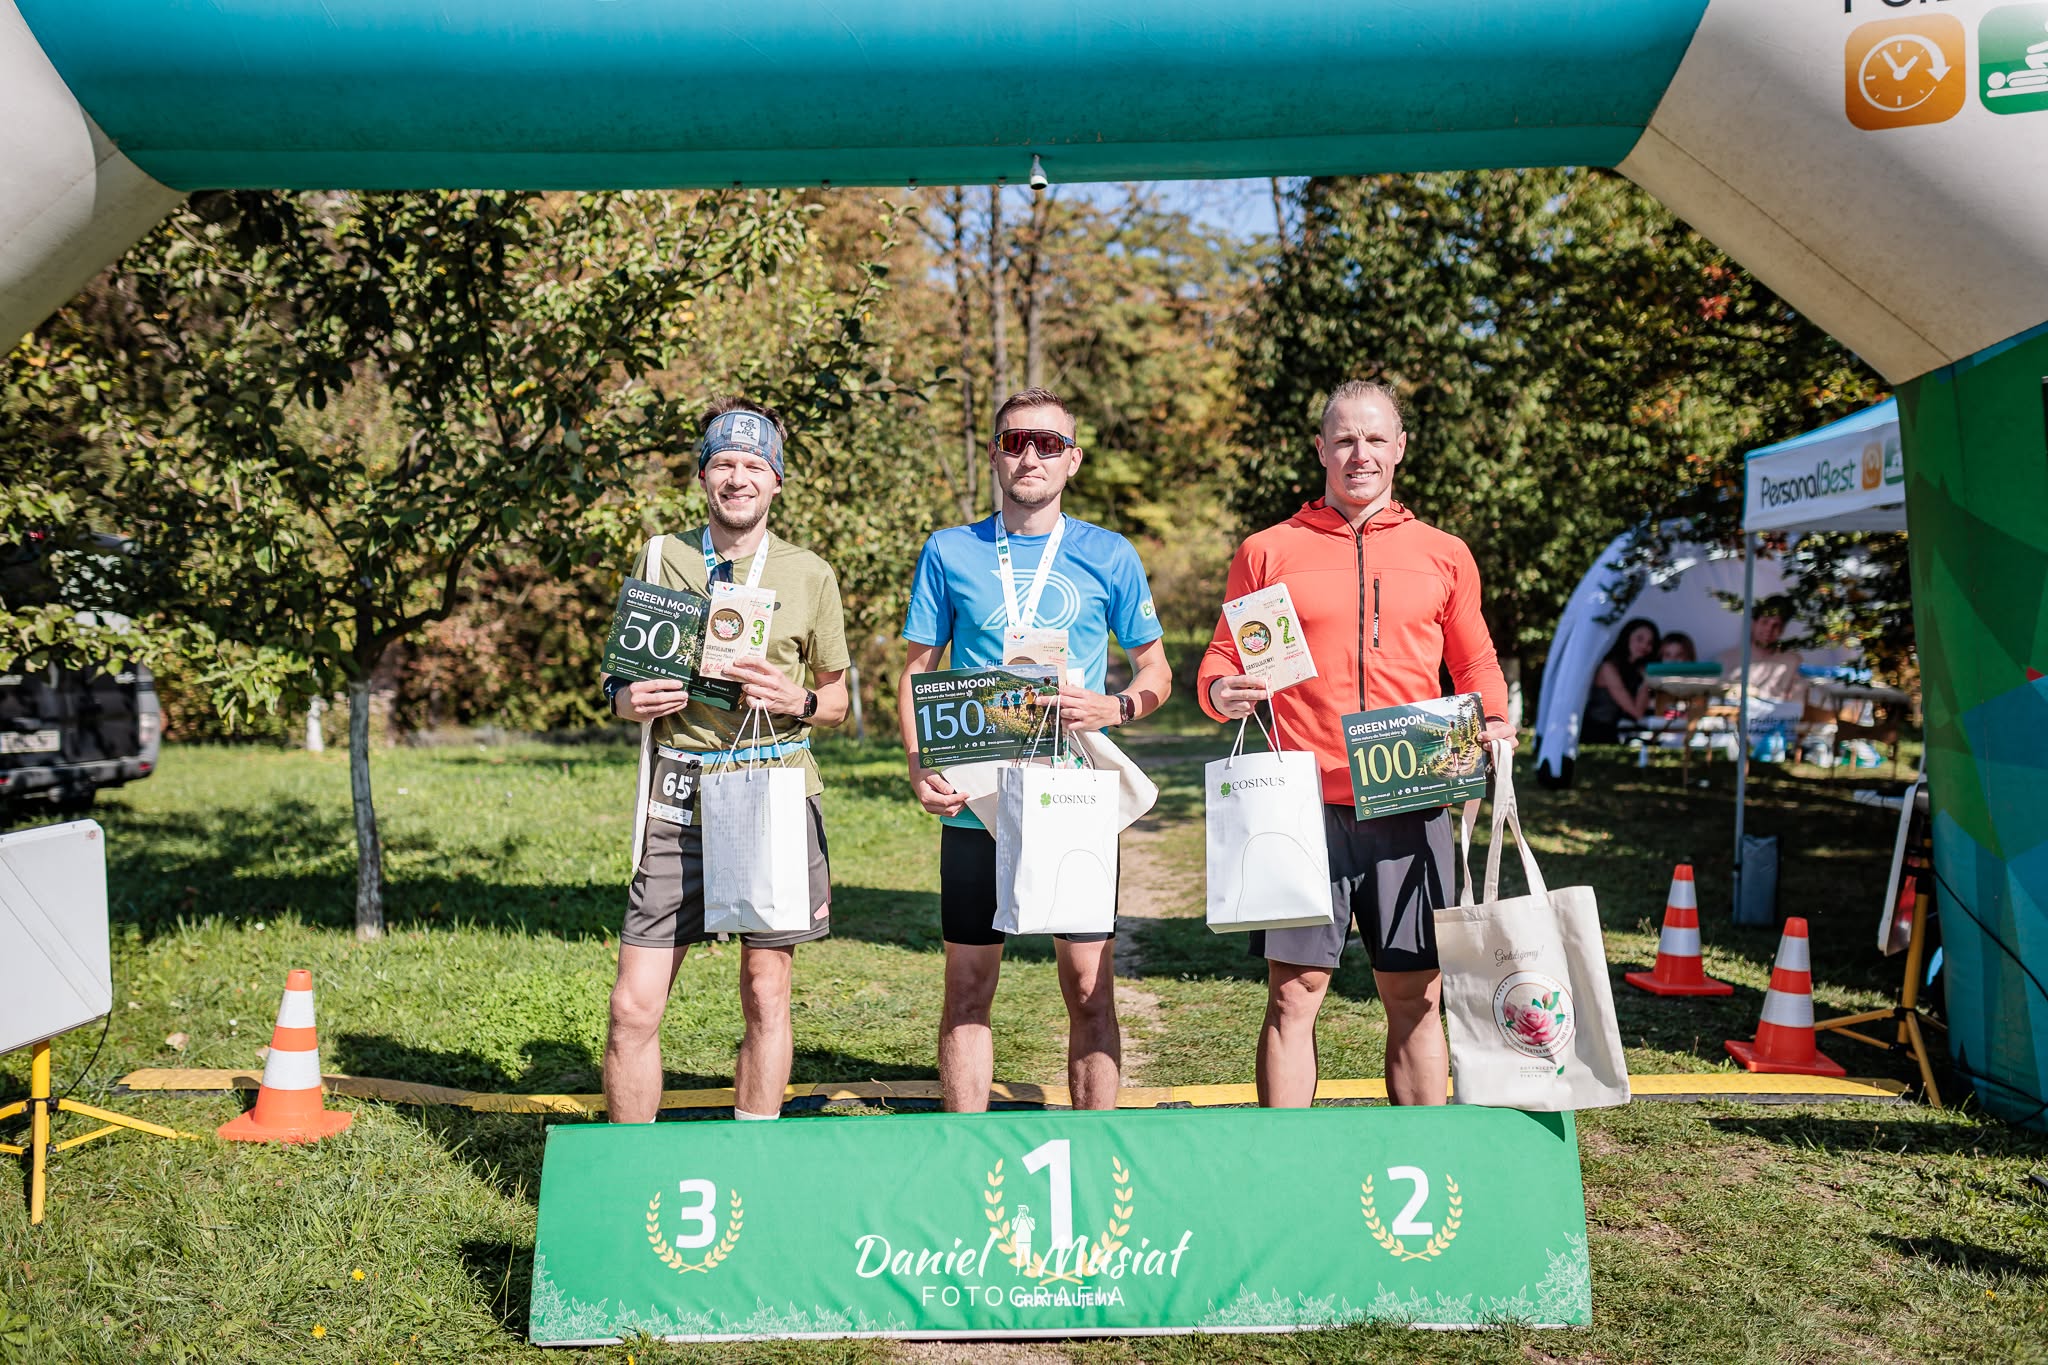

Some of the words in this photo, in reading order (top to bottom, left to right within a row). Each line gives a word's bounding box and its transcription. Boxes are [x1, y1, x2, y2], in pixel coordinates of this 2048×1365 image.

[1761, 459, 1856, 509] PersonalBest
[628, 588, 666, 607] GREEN
[667, 600, 702, 617] MOON
[619, 611, 681, 660] 50
[675, 653, 690, 666] zł
[751, 619, 765, 647] 3
[1277, 616, 1295, 644] 2
[915, 681, 955, 694] GREEN
[957, 677, 996, 690] MOON
[918, 700, 986, 741] 150
[986, 723, 996, 734] zł
[1348, 720, 1387, 736] GREEN
[1389, 714, 1425, 729] MOON
[1353, 740, 1417, 786] 100
[1417, 764, 1428, 776] zł
[663, 772, 693, 800] 65
[1232, 776, 1285, 791] COSINUS
[1052, 794, 1096, 804] COSINUS
[1021, 1139, 1073, 1250] 1
[1387, 1165, 1433, 1236] 2
[676, 1178, 717, 1249] 3
